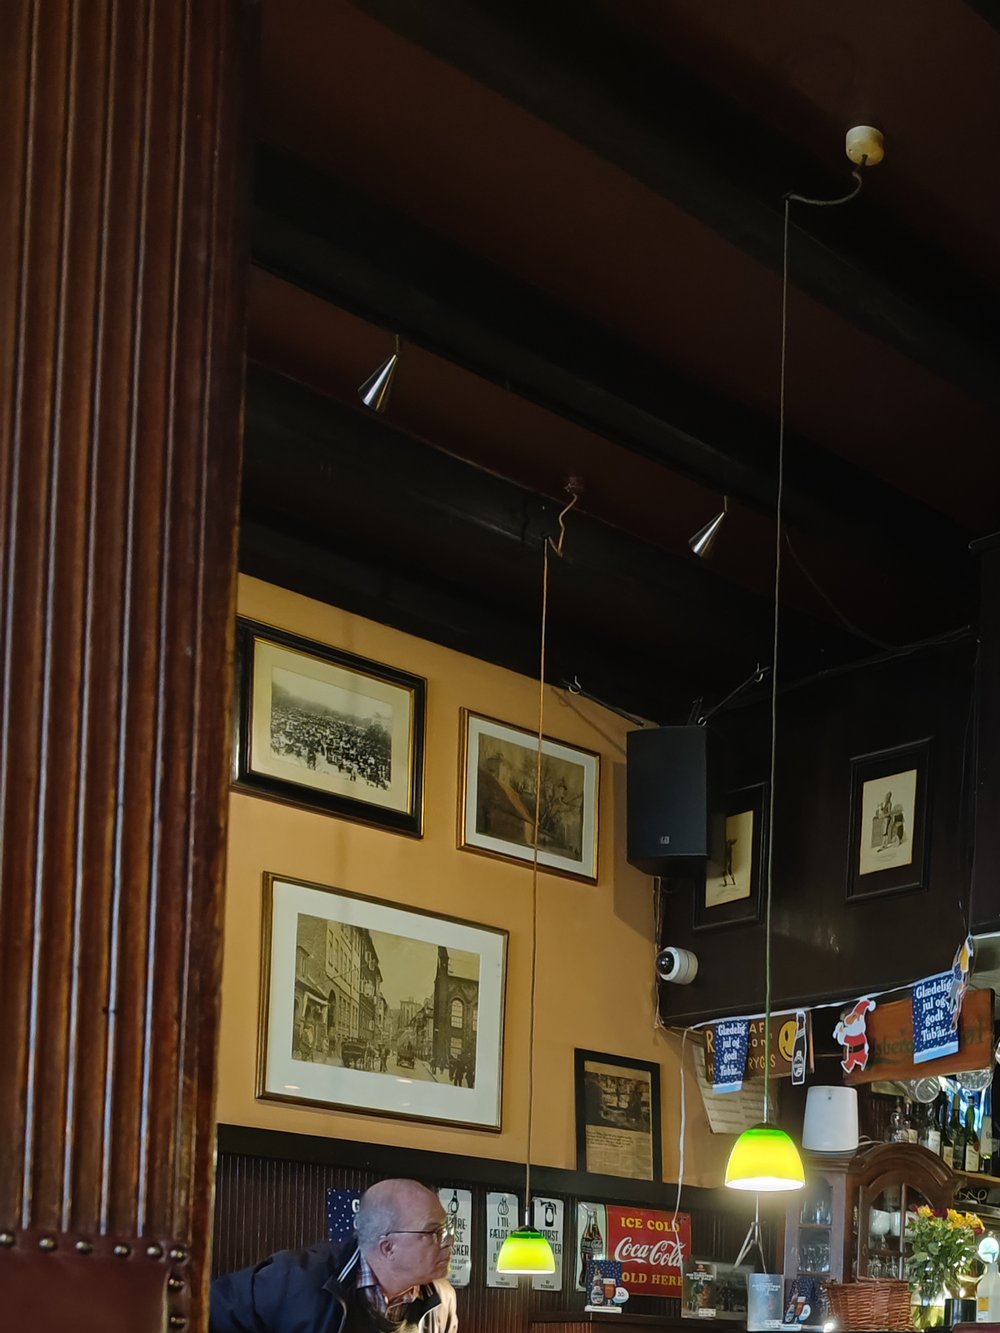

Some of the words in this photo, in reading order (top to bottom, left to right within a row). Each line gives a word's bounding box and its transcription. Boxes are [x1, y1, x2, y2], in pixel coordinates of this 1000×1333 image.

[916, 979, 952, 999] Glædelig
[922, 996, 933, 1014] jul
[935, 996, 946, 1008] og
[925, 1009, 944, 1027] godt
[621, 1217, 643, 1229] ICE
[647, 1220, 680, 1232] COLD
[622, 1272, 647, 1284] OLD
